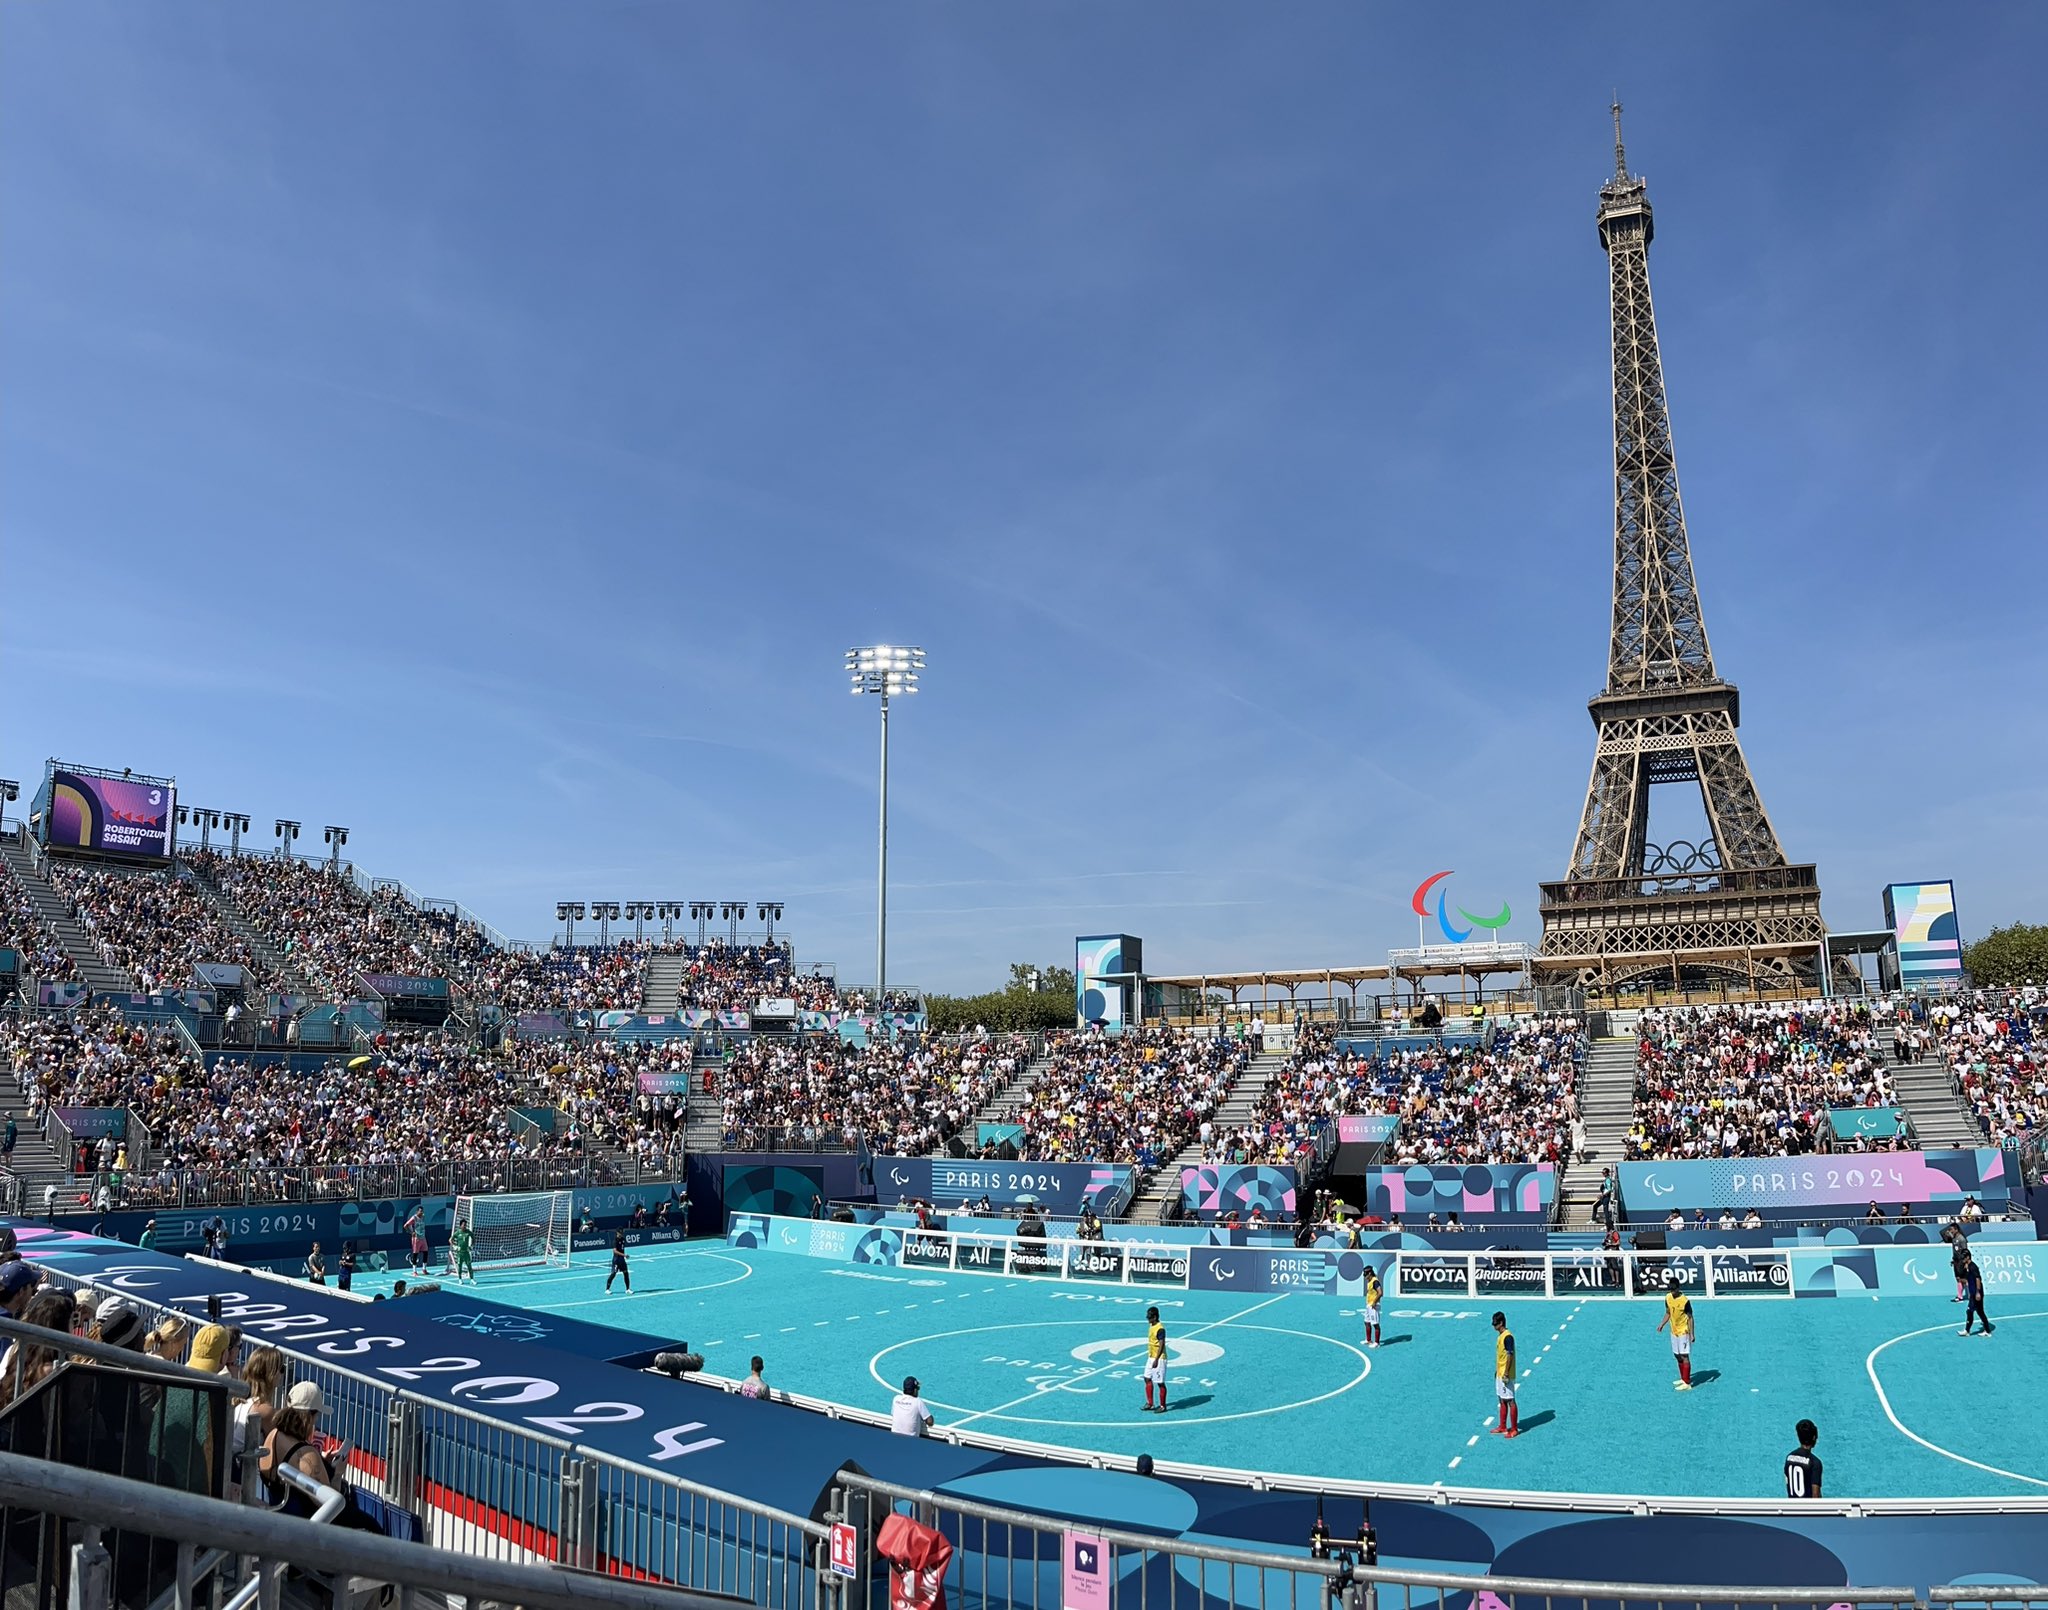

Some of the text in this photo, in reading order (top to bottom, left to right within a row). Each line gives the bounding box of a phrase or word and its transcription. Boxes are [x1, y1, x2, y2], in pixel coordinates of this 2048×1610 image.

[148, 789, 161, 806] 3
[103, 832, 141, 846] SASAKI
[1008, 1174, 1060, 1192] 2024
[1827, 1168, 1904, 1190] 2024
[260, 1214, 316, 1234] 2024
[573, 1238, 606, 1248] Panasonic
[905, 1243, 950, 1259] TOYOTA
[1010, 1252, 1063, 1267] Panasonic
[1129, 1258, 1170, 1274] Allianz
[1271, 1272, 1309, 1285] 2024
[1401, 1268, 1467, 1282] TOYOTA
[1713, 1267, 1767, 1283] Allianz
[1986, 1270, 2036, 1283] 2024
[1050, 1291, 1185, 1308] TOYOTA
[376, 1357, 726, 1461] 2024
[1788, 1464, 1805, 1498] 10
